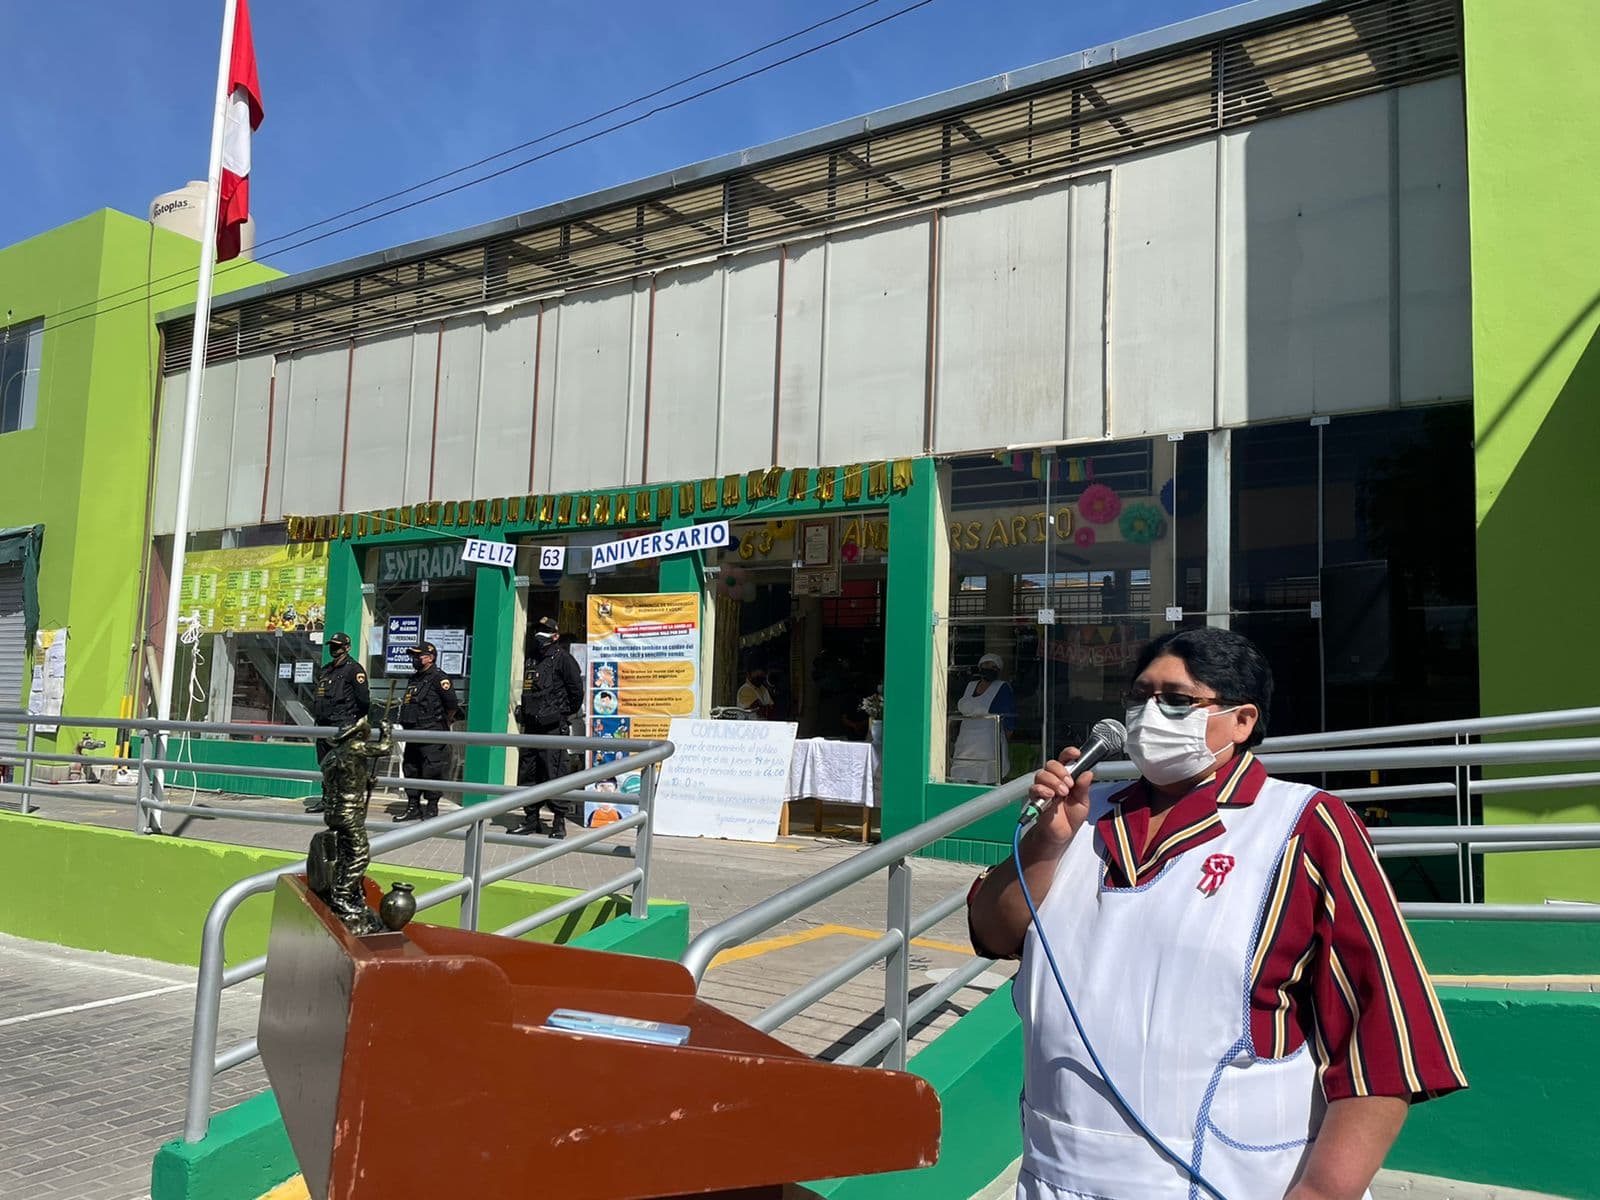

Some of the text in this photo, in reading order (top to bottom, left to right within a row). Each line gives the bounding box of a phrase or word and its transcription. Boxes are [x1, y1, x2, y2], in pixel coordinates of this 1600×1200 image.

[467, 524, 726, 567] FELIZ 63 ANIVERSARIO
